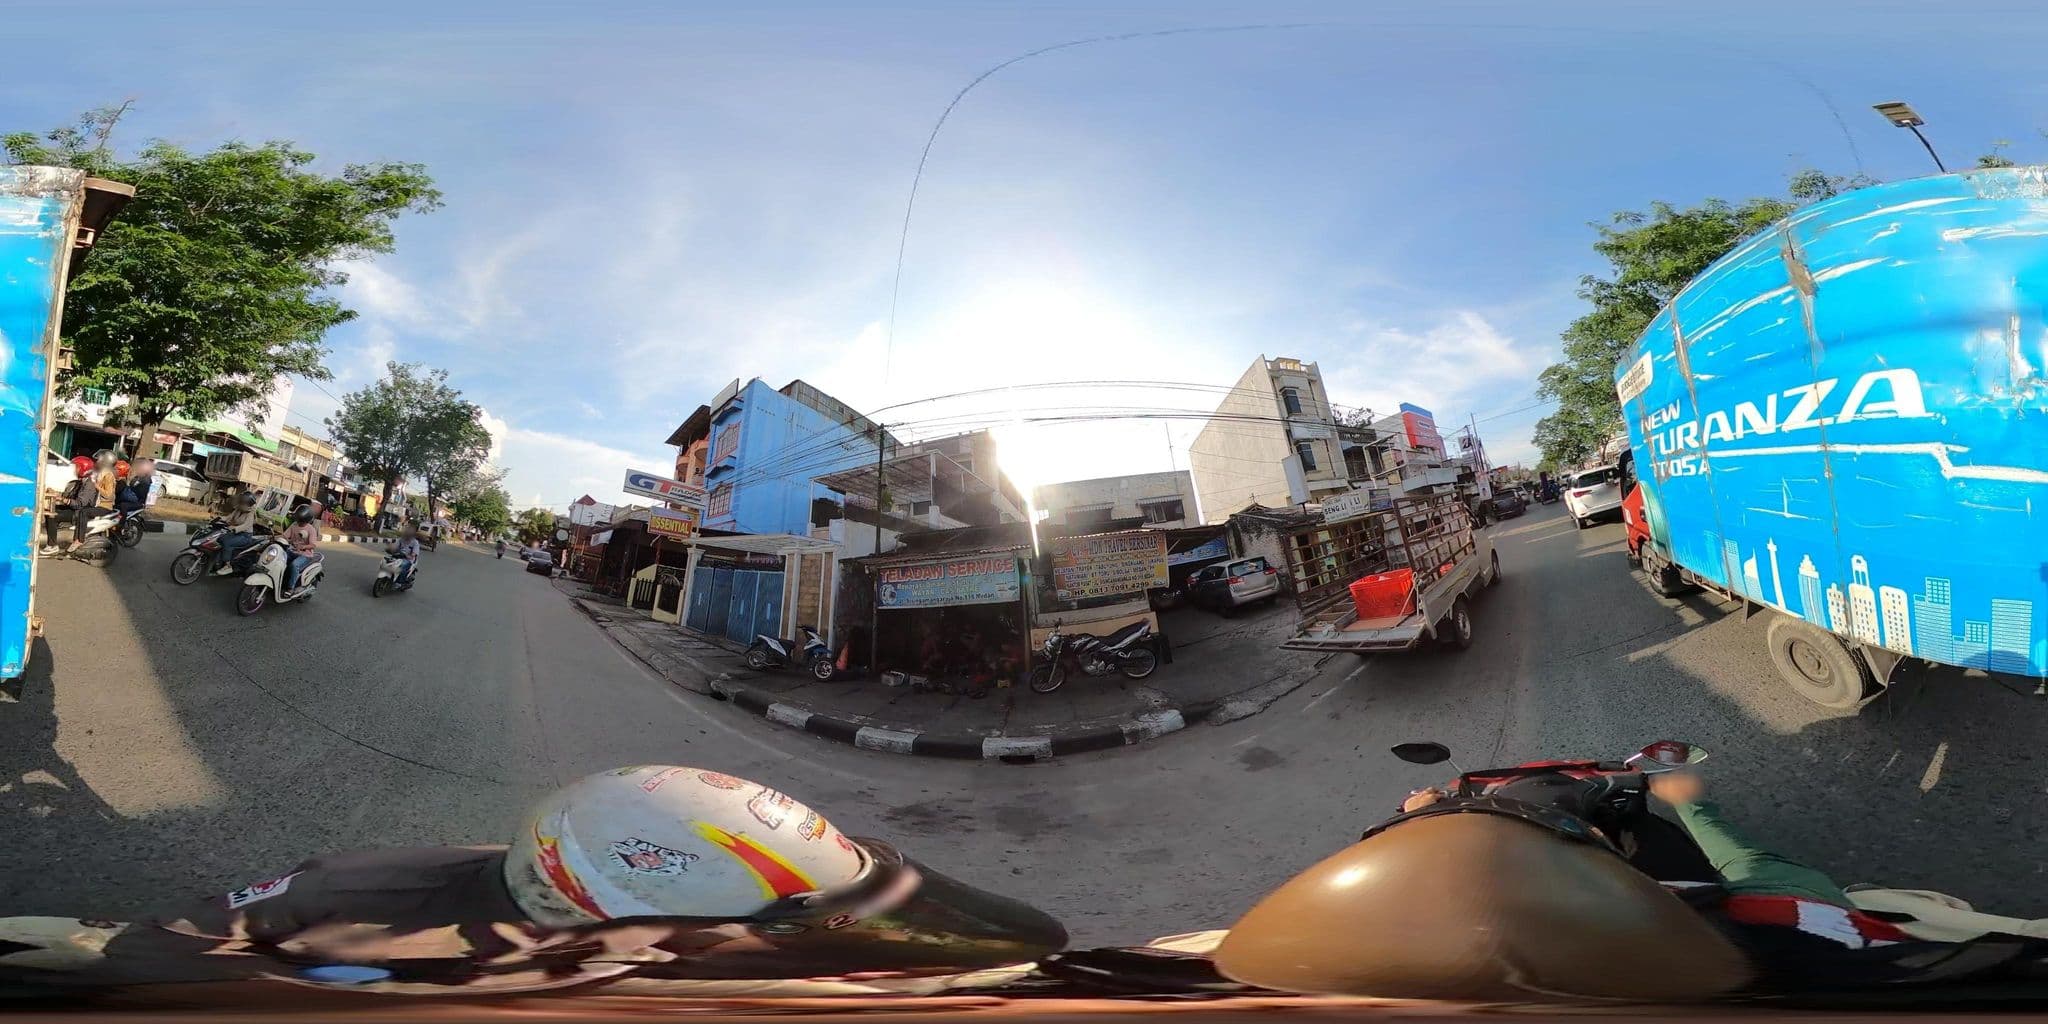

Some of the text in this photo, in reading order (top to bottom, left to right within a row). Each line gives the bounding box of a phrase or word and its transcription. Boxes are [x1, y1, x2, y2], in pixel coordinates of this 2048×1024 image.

[1641, 399, 1680, 434] NEW
[1646, 368, 1927, 455] TURANZA
[651, 516, 690, 534] ESSENTIAL
[947, 559, 1015, 578] SERVICE
